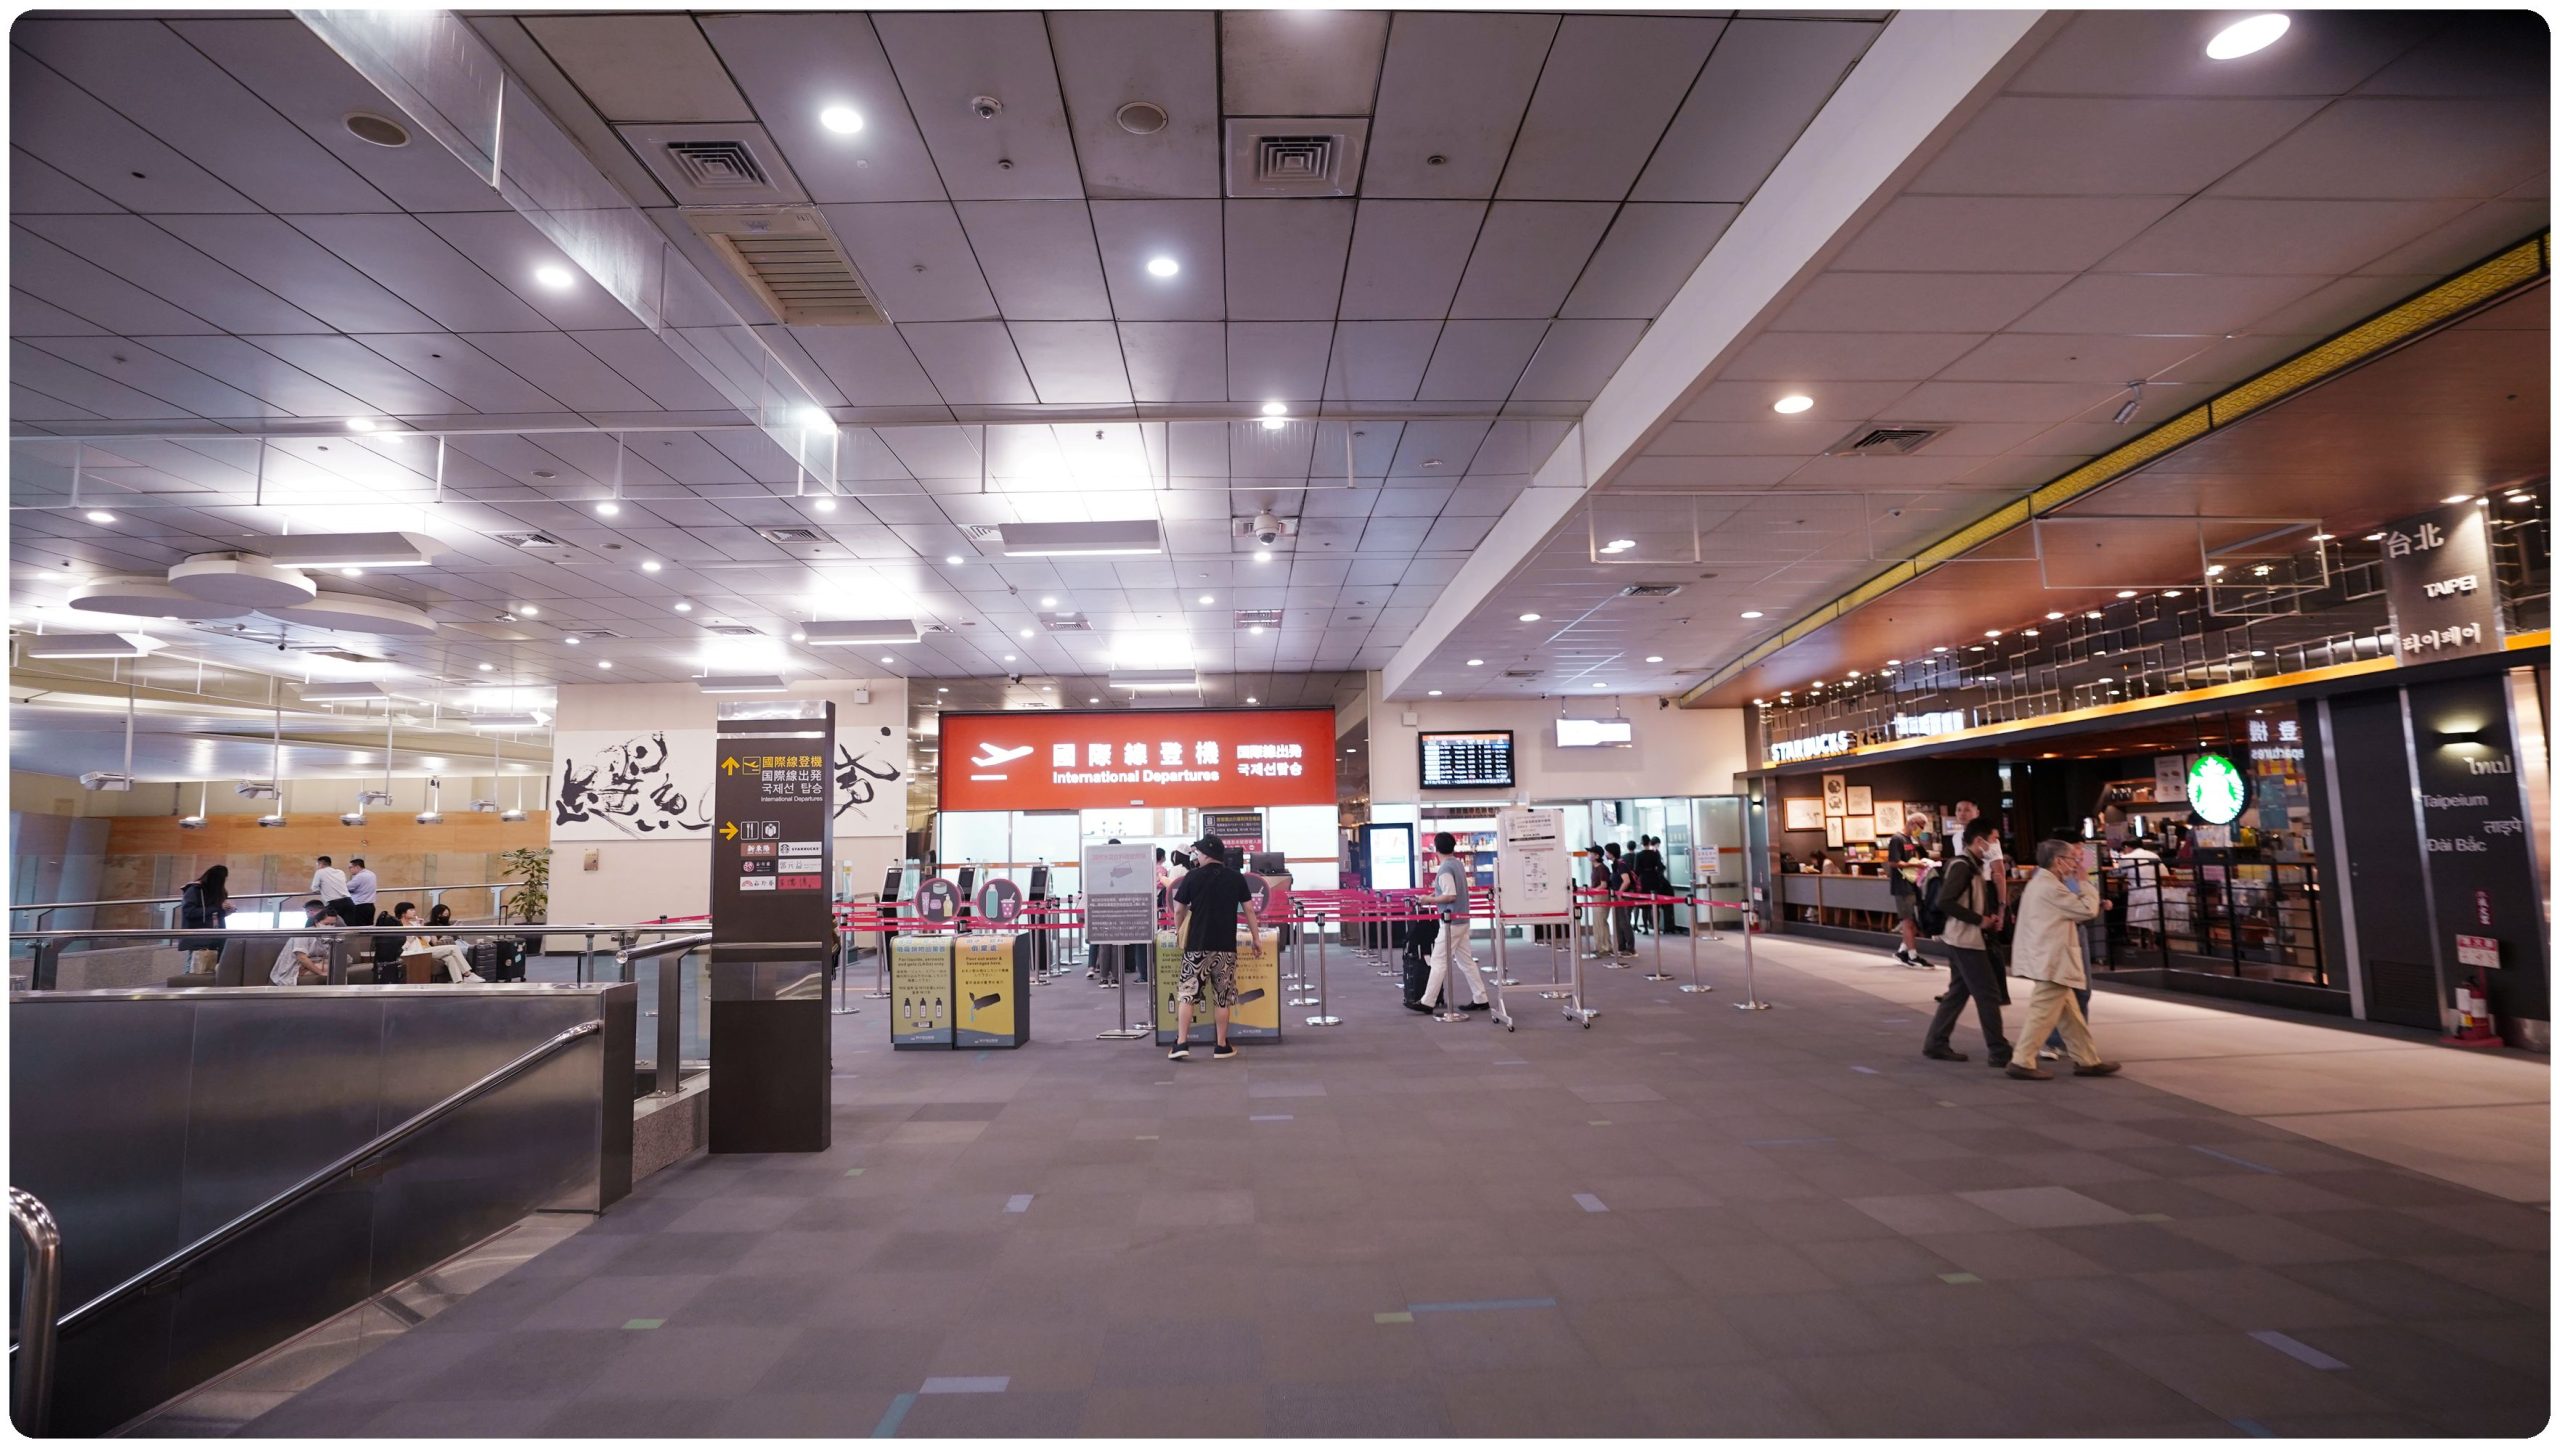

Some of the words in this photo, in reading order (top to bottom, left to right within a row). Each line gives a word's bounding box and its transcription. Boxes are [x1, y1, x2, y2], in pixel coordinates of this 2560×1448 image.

[2386, 522, 2445, 559] 台北
[2423, 574, 2478, 598] TAIPEI
[1053, 741, 1219, 767] 國際線登機
[1770, 730, 1849, 762] STARBUCKS
[762, 756, 823, 768] 國際線登機
[761, 769, 822, 782] 国際線出発
[1052, 770, 1140, 784] International
[1142, 769, 1220, 784] Departures
[761, 783, 795, 795] 국제선
[801, 783, 823, 794] 탑승
[793, 795, 823, 803] Departures
[2421, 793, 2489, 810] Taipeium
